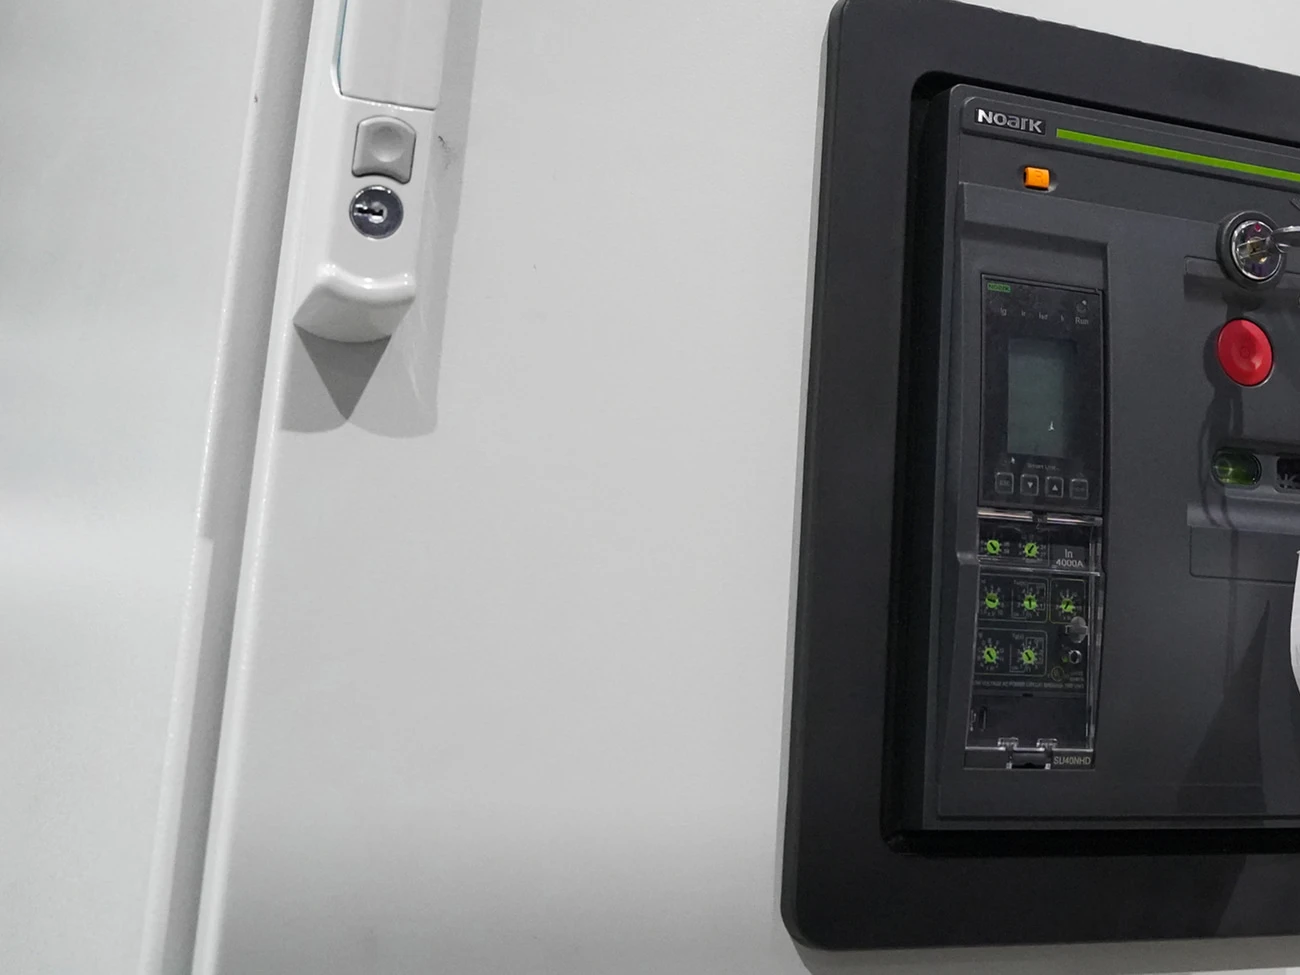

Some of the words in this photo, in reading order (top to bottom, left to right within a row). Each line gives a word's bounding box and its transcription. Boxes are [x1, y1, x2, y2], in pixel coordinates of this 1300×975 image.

[1075, 316, 1089, 324] Run
[1064, 548, 1073, 558] In
[1056, 558, 1084, 568] 4000A
[1054, 756, 1092, 765] SU40NHD
